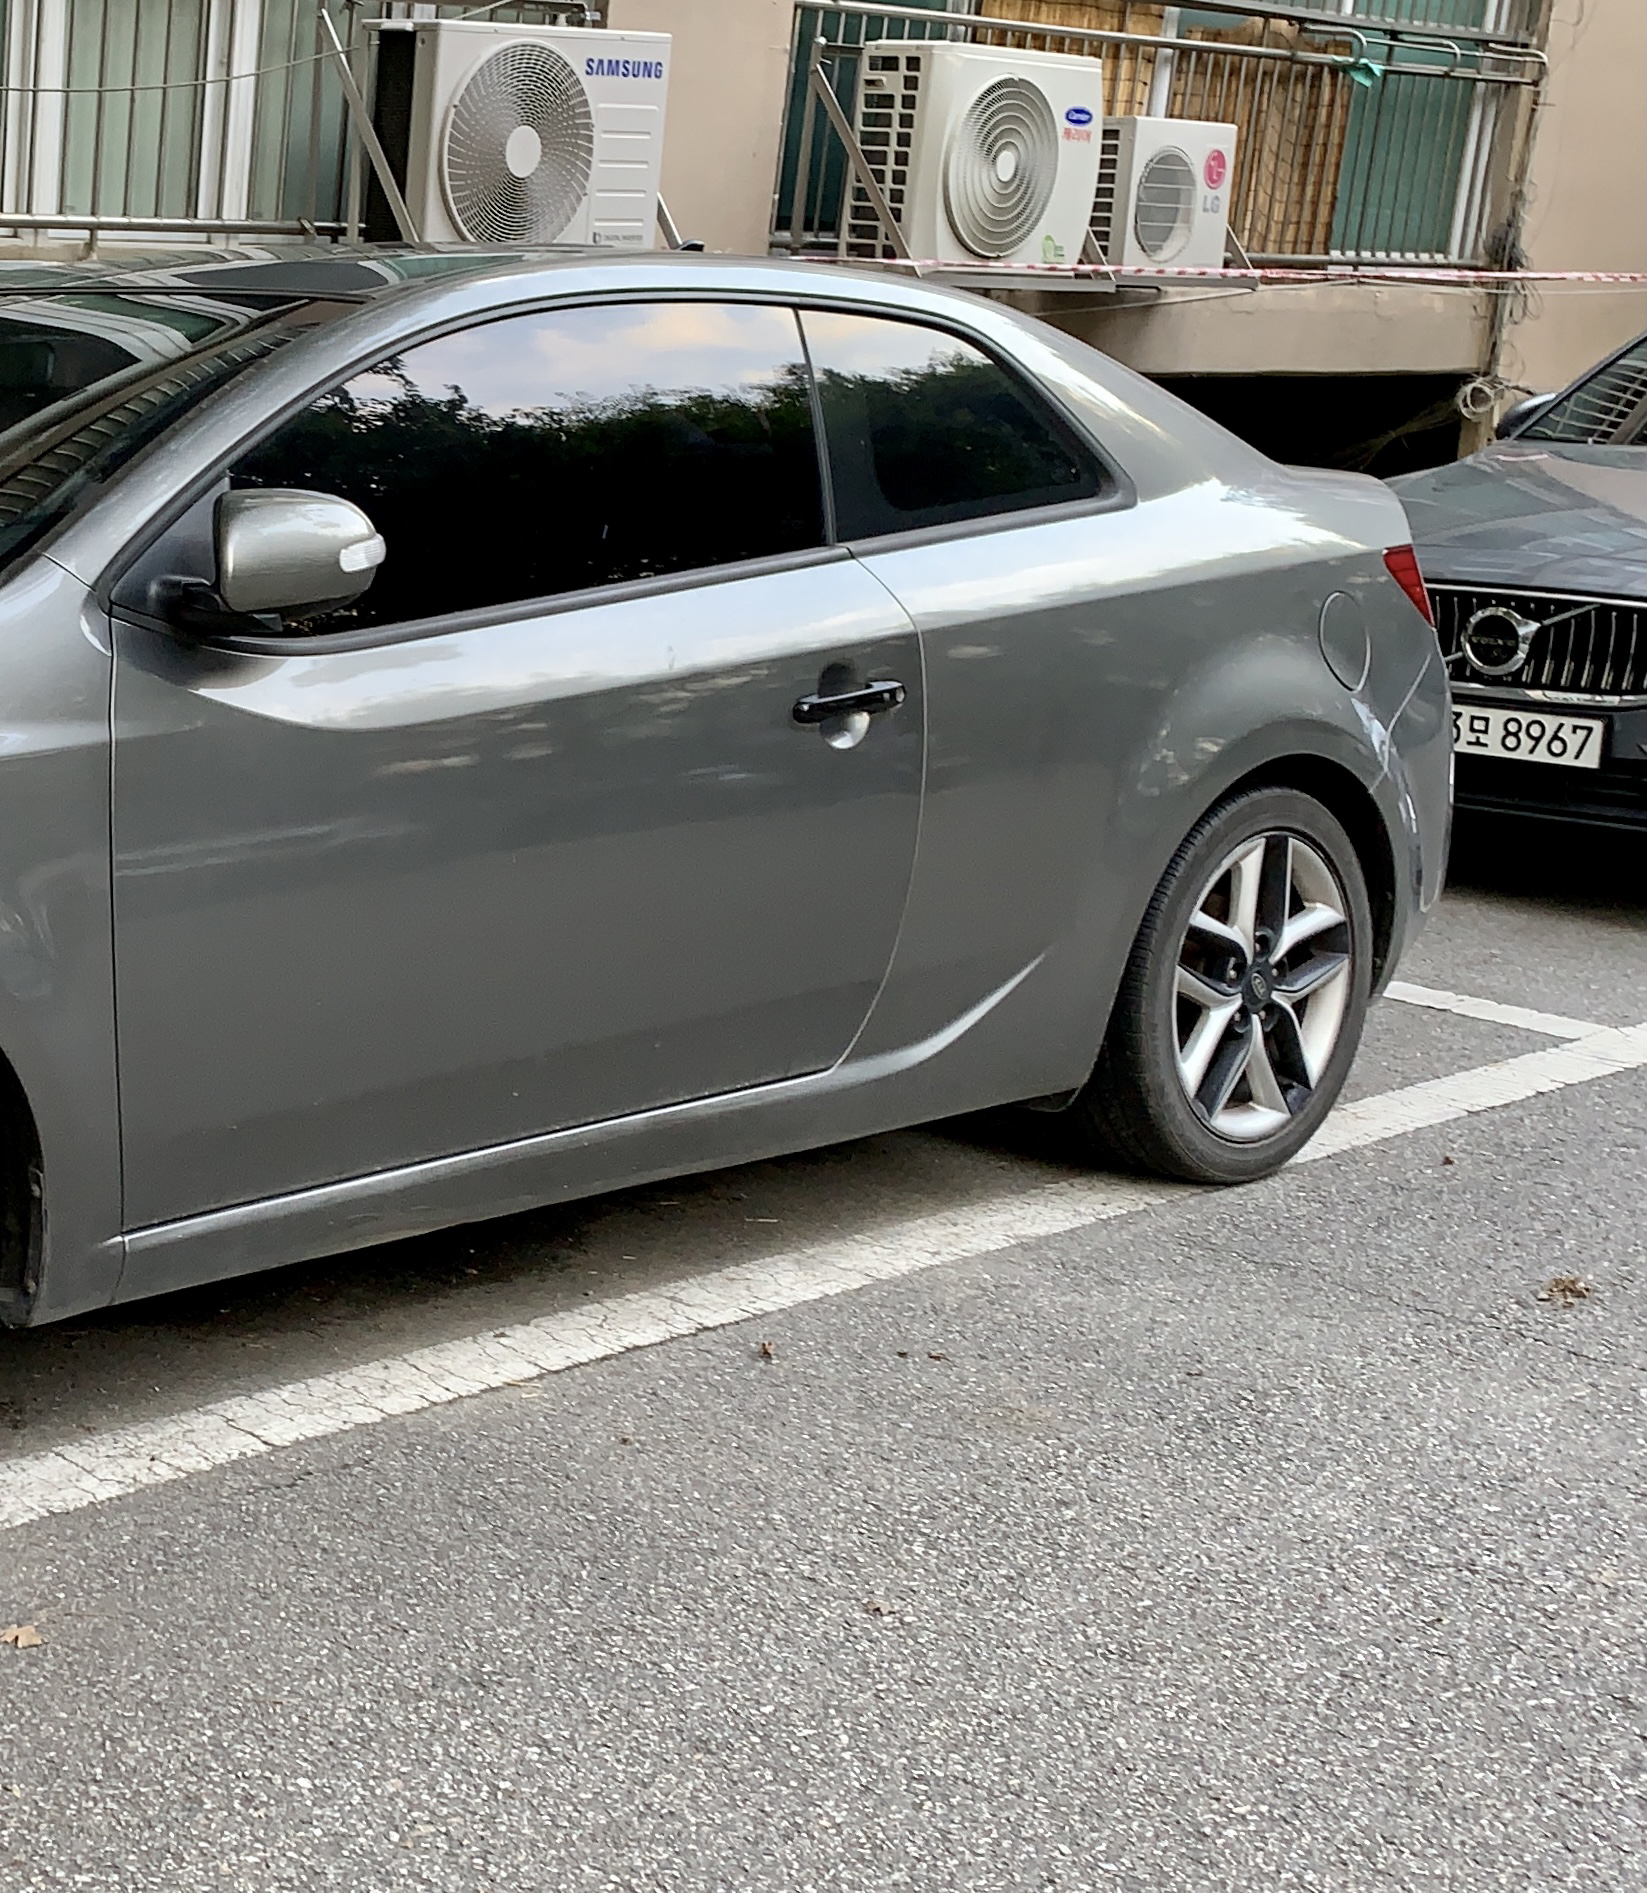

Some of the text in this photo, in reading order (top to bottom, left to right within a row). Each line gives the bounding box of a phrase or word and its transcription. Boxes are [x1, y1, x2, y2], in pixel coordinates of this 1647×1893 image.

[585, 57, 664, 80] SAMSUNG
[1202, 195, 1221, 214] LG
[1500, 717, 1594, 760] 8967
